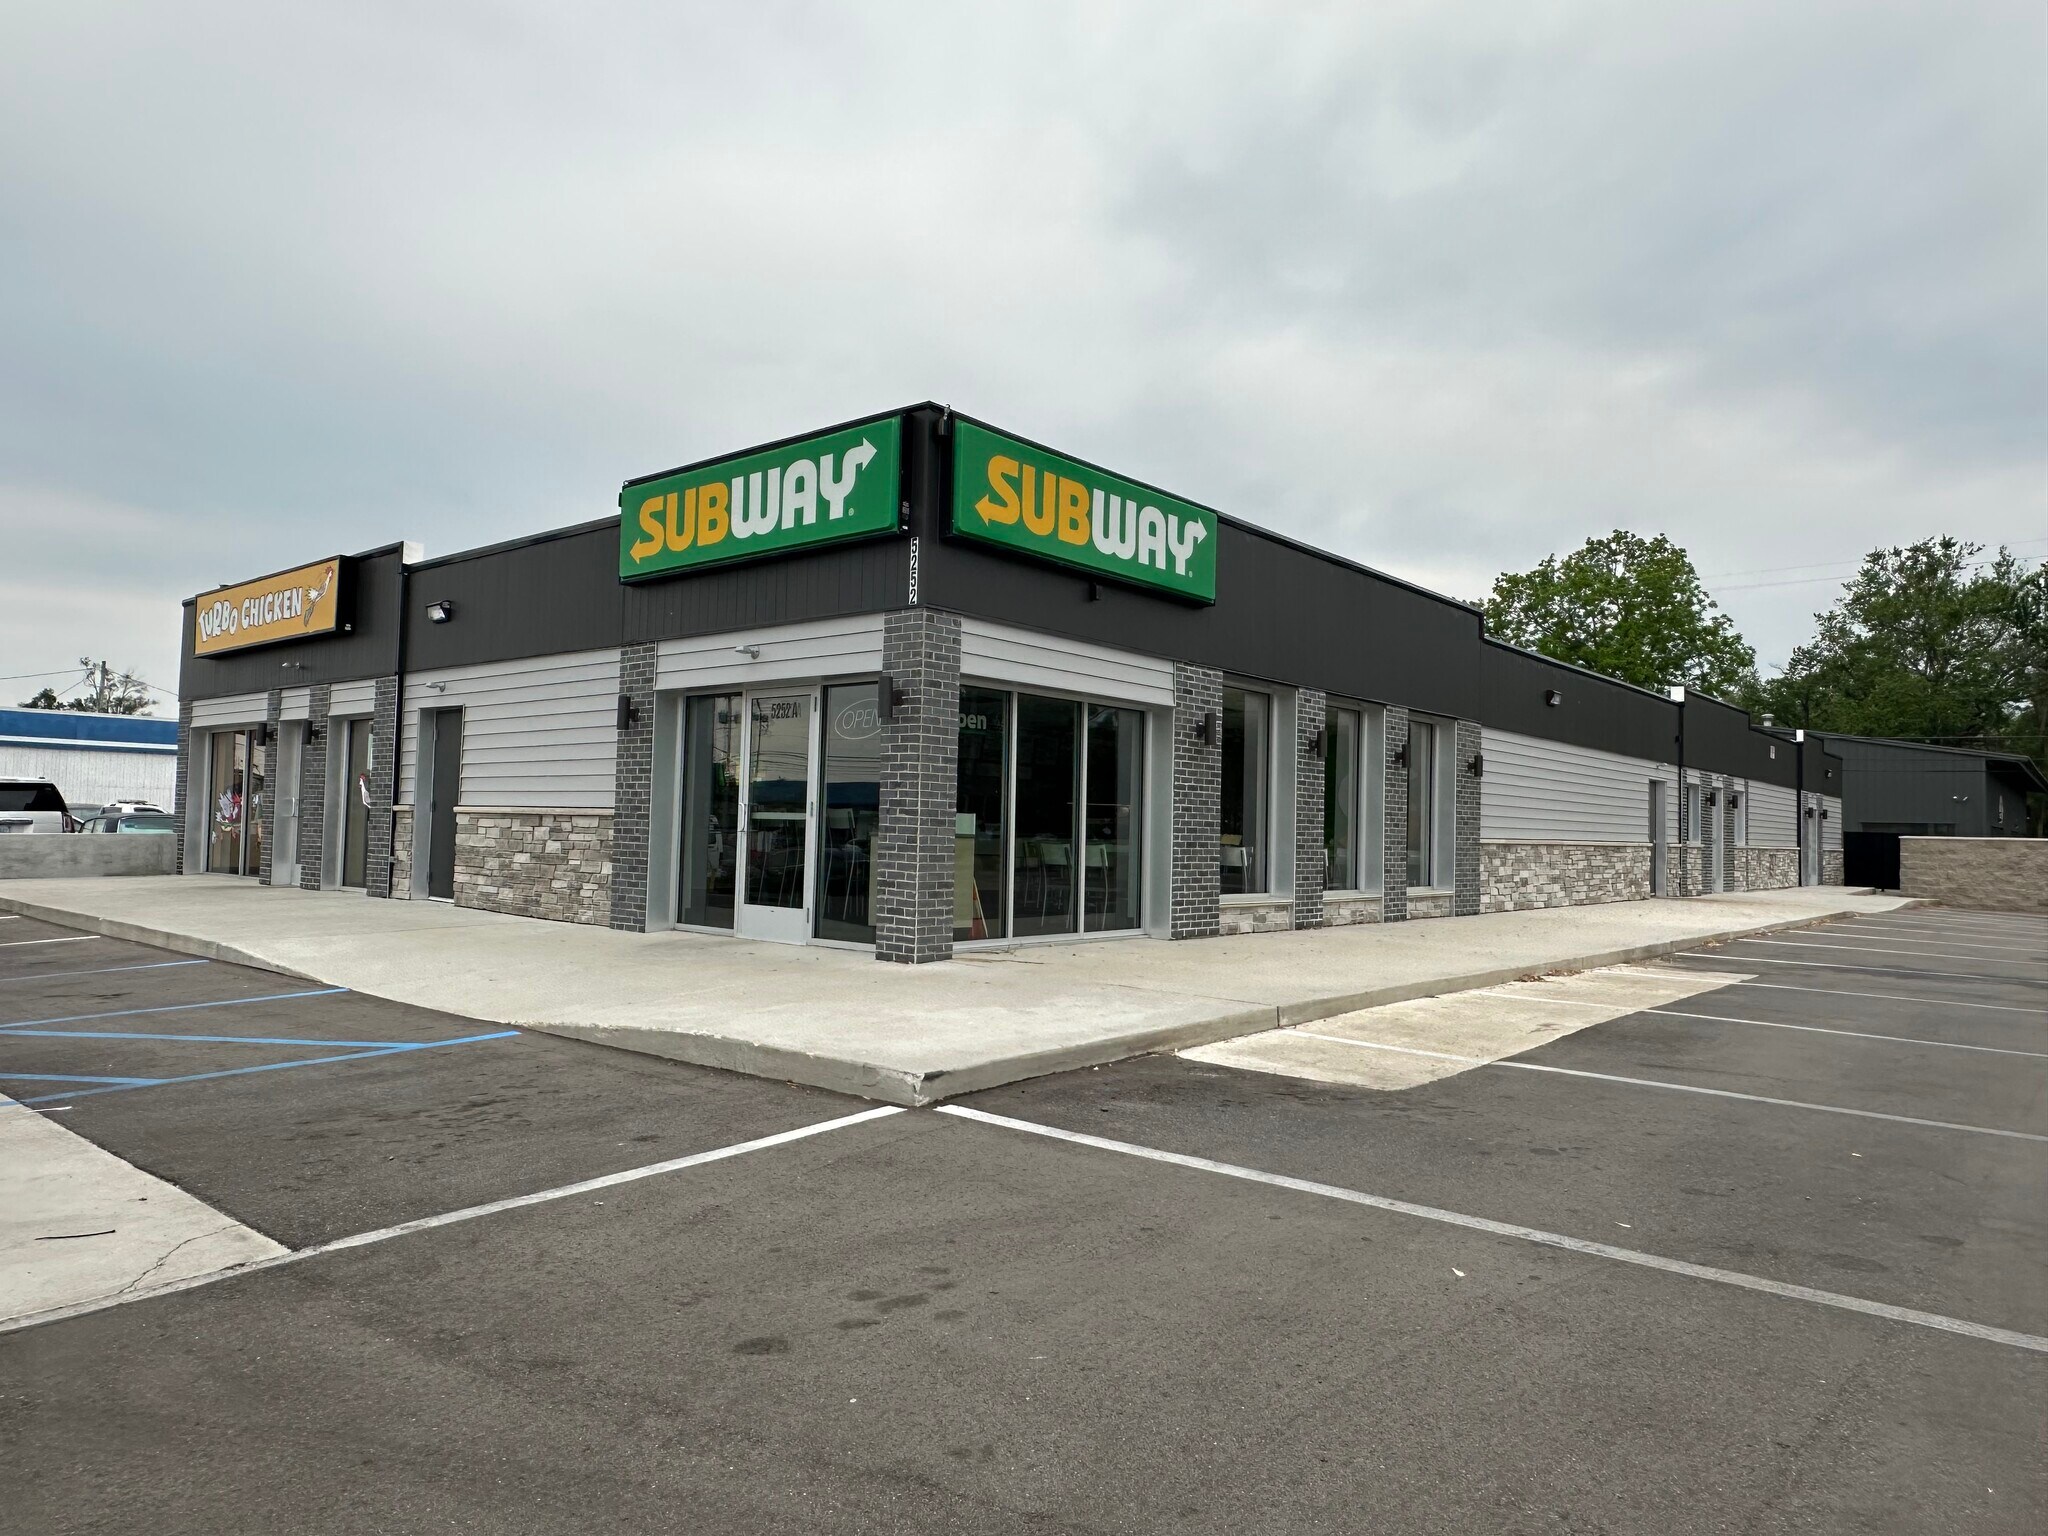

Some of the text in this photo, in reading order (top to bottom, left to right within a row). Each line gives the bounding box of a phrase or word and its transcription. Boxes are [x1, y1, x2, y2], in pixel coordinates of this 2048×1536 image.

[629, 437, 877, 565] SUBWAY
[974, 455, 1208, 576] SUBWAY
[909, 537, 918, 605] 5252
[198, 587, 303, 642] TURBO CHICKEN
[771, 703, 791, 719] 5252
[842, 708, 882, 729] OPEN
[959, 713, 987, 730] pen
